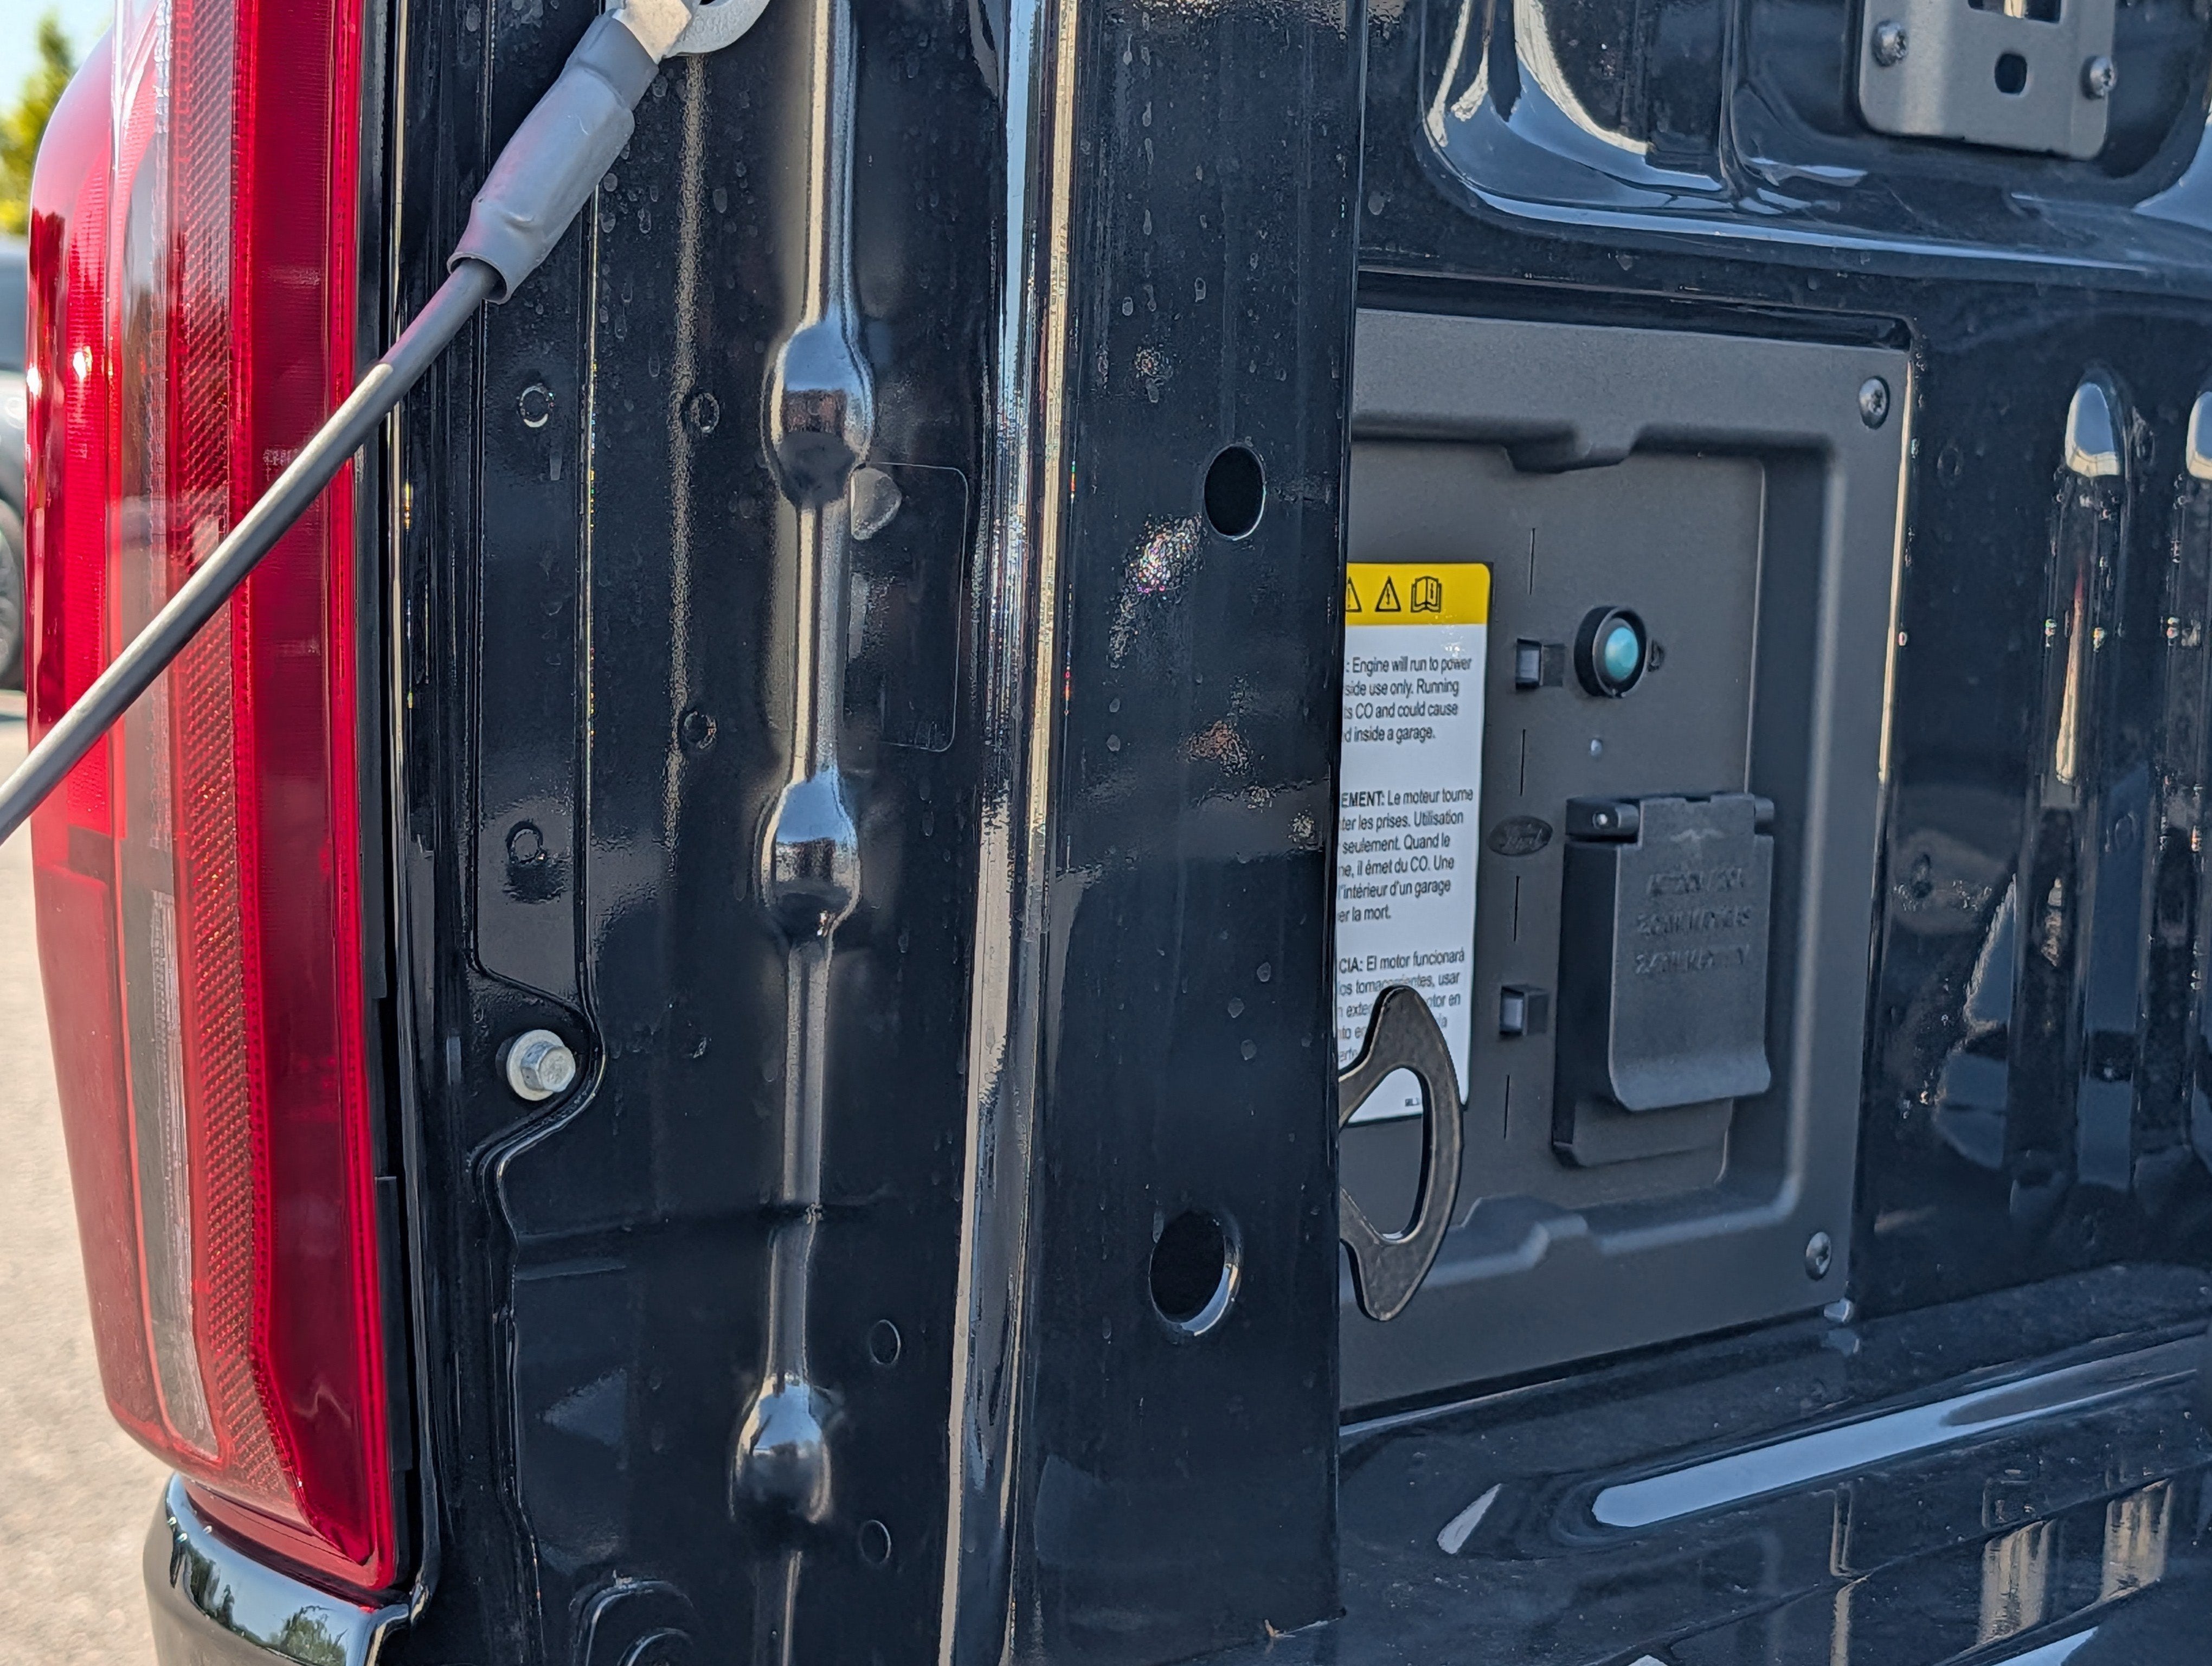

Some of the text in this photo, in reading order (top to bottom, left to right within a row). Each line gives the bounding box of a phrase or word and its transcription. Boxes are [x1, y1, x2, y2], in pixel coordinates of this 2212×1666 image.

[1353, 656, 1389, 677] Engine
[1392, 656, 1408, 671] will
[1410, 659, 1427, 671] run
[1429, 656, 1439, 671] to
[1441, 658, 1472, 674] power
[1369, 683, 1388, 696] use
[1390, 679, 1413, 699] only.
[1417, 678, 1459, 697] Running
[1355, 702, 1373, 719] CO
[1375, 702, 1395, 719] and
[1398, 701, 1425, 717] could
[1427, 703, 1458, 716] cause
[1354, 726, 1385, 742] inside
[1387, 730, 1394, 741] a
[1396, 727, 1436, 745] garage.
[1341, 790, 1385, 808] EMENT:
[1387, 790, 1400, 805] Le
[1403, 789, 1439, 804] moteur
[1359, 814, 1373, 830] les
[1376, 813, 1411, 832] prises.
[1414, 809, 1464, 828] Utilisation
[1342, 832, 1450, 854] seulement. Quand le
[1365, 859, 1392, 876] émet
[1394, 857, 1408, 873] du
[1410, 855, 1431, 873] CO.
[1433, 855, 1454, 871] Une
[1390, 880, 1412, 896] d'un
[1414, 880, 1451, 899] garage
[1352, 906, 1361, 922] la
[1364, 904, 1392, 920] mort.
[1339, 947, 1464, 974] CIA: El motor funcionará
[1438, 972, 1460, 985] usar
[1449, 994, 1461, 1007] en
